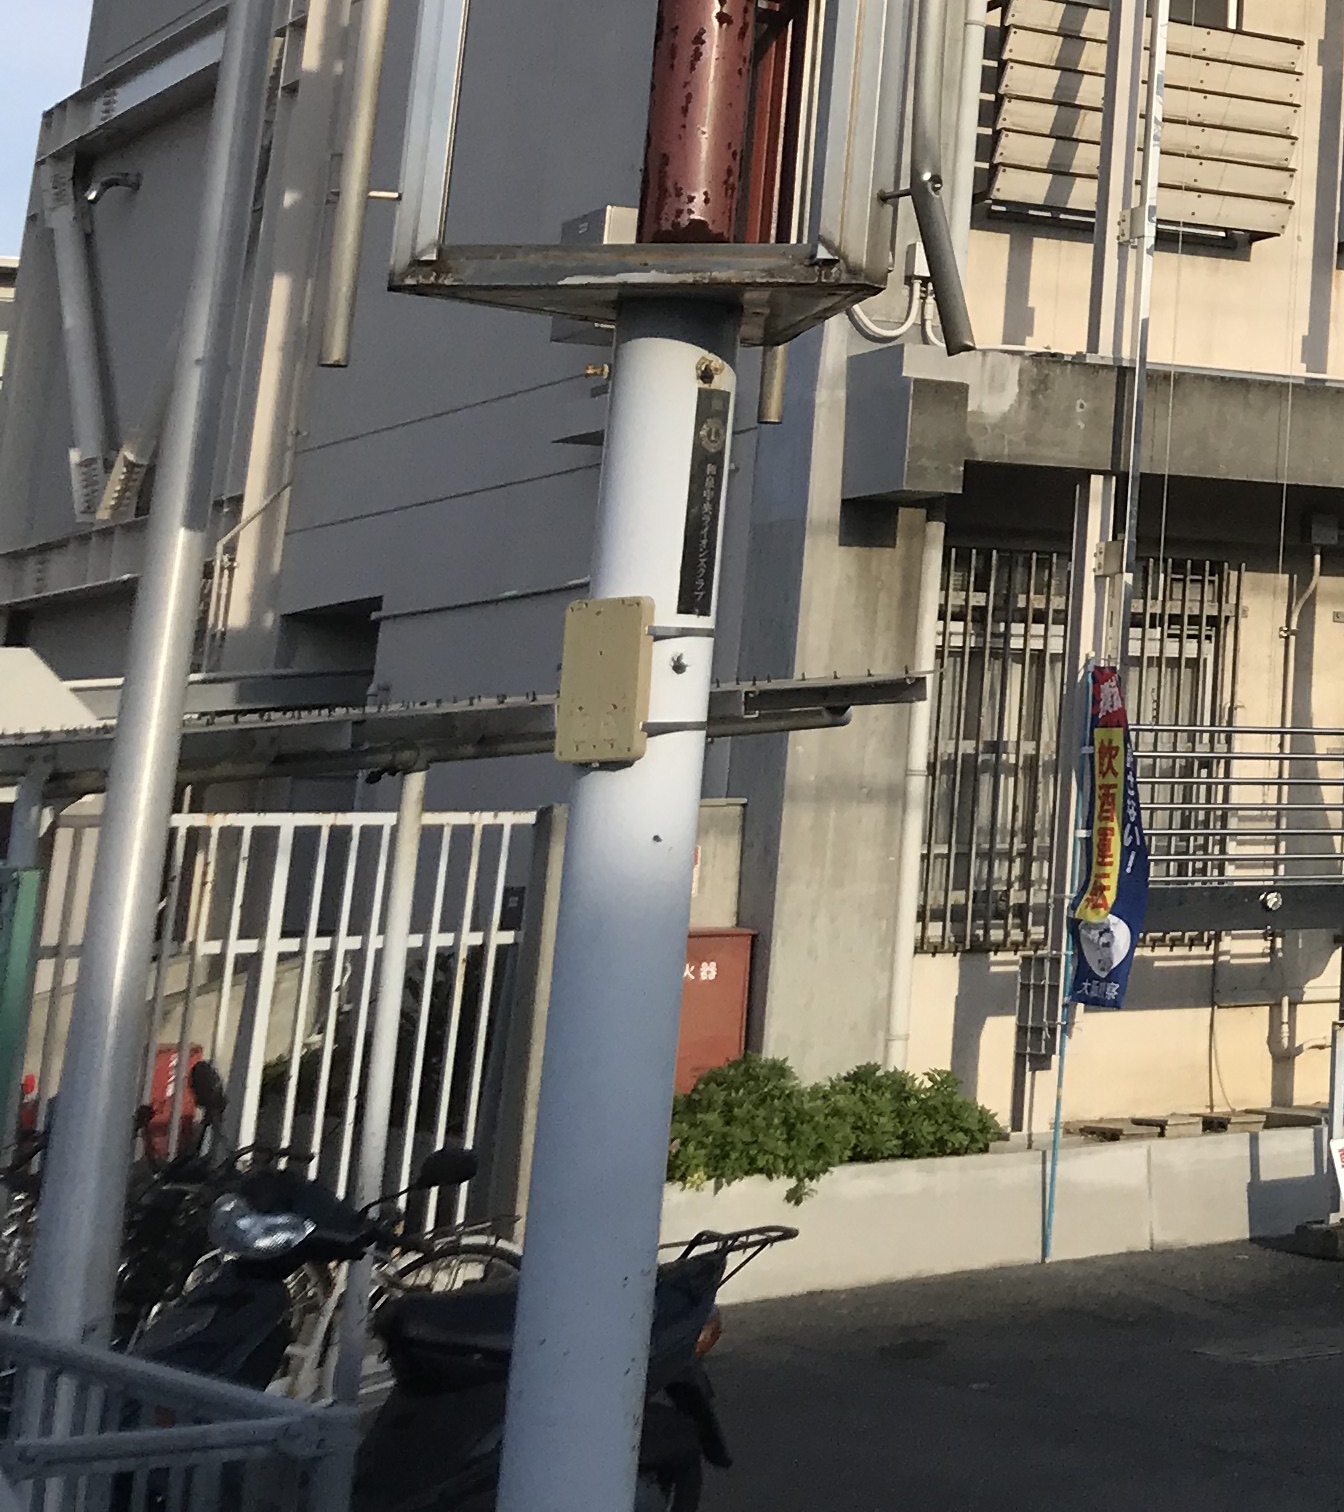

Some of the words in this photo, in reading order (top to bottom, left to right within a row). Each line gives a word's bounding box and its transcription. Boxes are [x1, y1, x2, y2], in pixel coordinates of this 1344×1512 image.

[1085, 738, 1120, 912] 飲酒運転
[683, 962, 717, 981] 火器
